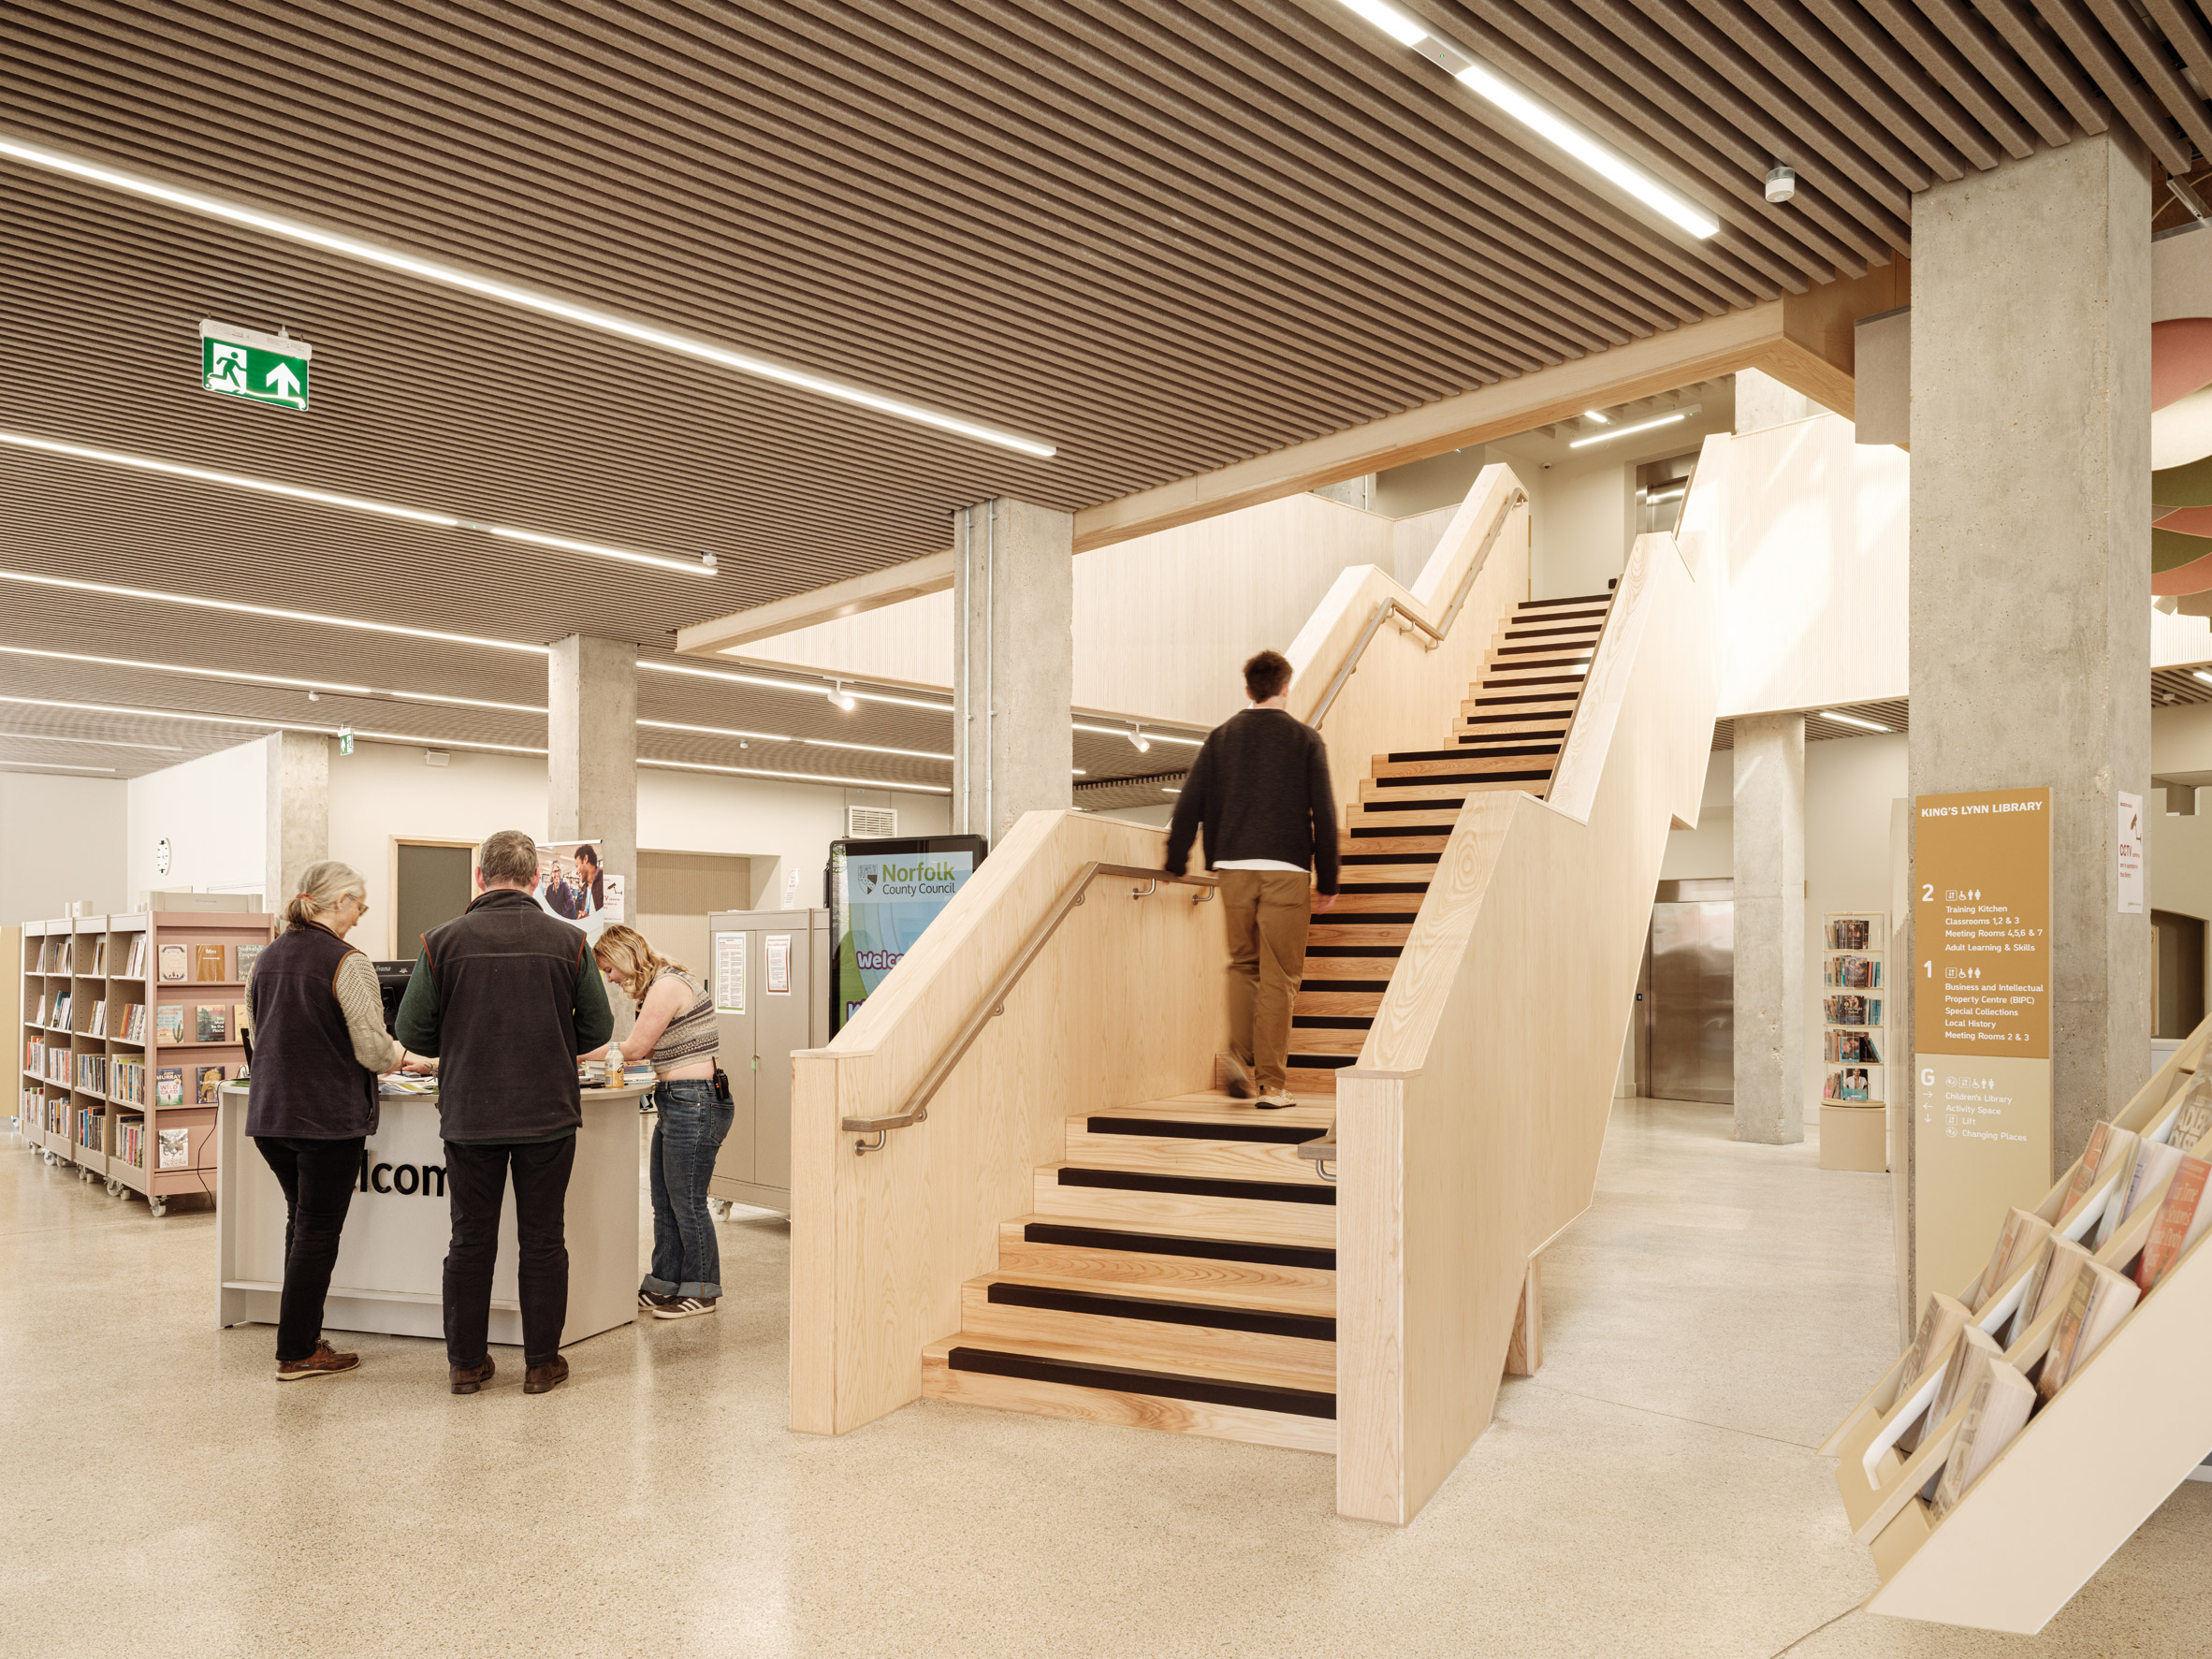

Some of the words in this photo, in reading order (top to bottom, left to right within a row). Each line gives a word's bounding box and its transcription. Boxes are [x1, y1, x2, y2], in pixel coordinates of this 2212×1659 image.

[1921, 807, 1958, 818] KING'S
[1961, 805, 1989, 815] LYNN
[1992, 801, 2043, 813] LIBRARY
[2119, 844, 2132, 857] CCTV
[882, 861, 955, 882] Norfolk
[882, 884, 917, 896] County
[919, 882, 955, 895] Council
[1922, 883, 1934, 901] 2
[1945, 906, 1975, 914] Training
[1945, 917, 1990, 925] Classrooms
[1992, 917, 2003, 925] 1,2
[1945, 929, 1975, 939] Meeting
[2007, 929, 2026, 938] 4,5,6
[1968, 944, 2001, 953] Learning
[855, 949, 905, 970] Welc
[1923, 960, 1932, 978] 1
[1999, 983, 2044, 992] Intellectual
[1945, 996, 1979, 1005] Property
[1981, 996, 2007, 1004] Centre
[2010, 997, 2035, 1005] (BIPC)
[1945, 1007, 1973, 1015] Special
[1975, 1008, 2018, 1016] Collections
[1968, 1020, 1996, 1029] History
[1945, 1031, 1975, 1041] Meeting
[2015, 1033, 2022, 1041] &
[1920, 1068, 1935, 1086] G
[1945, 1093, 1982, 1102] Children's
[1984, 1094, 2013, 1104] Library
[1945, 1105, 1975, 1113] Activity
[1977, 1106, 2001, 1115] Space
[1962, 1117, 1976, 1126] Lift
[1962, 1129, 1998, 1141] Changing
[2001, 1132, 2028, 1142] Places
[360, 1149, 447, 1197] lcom
